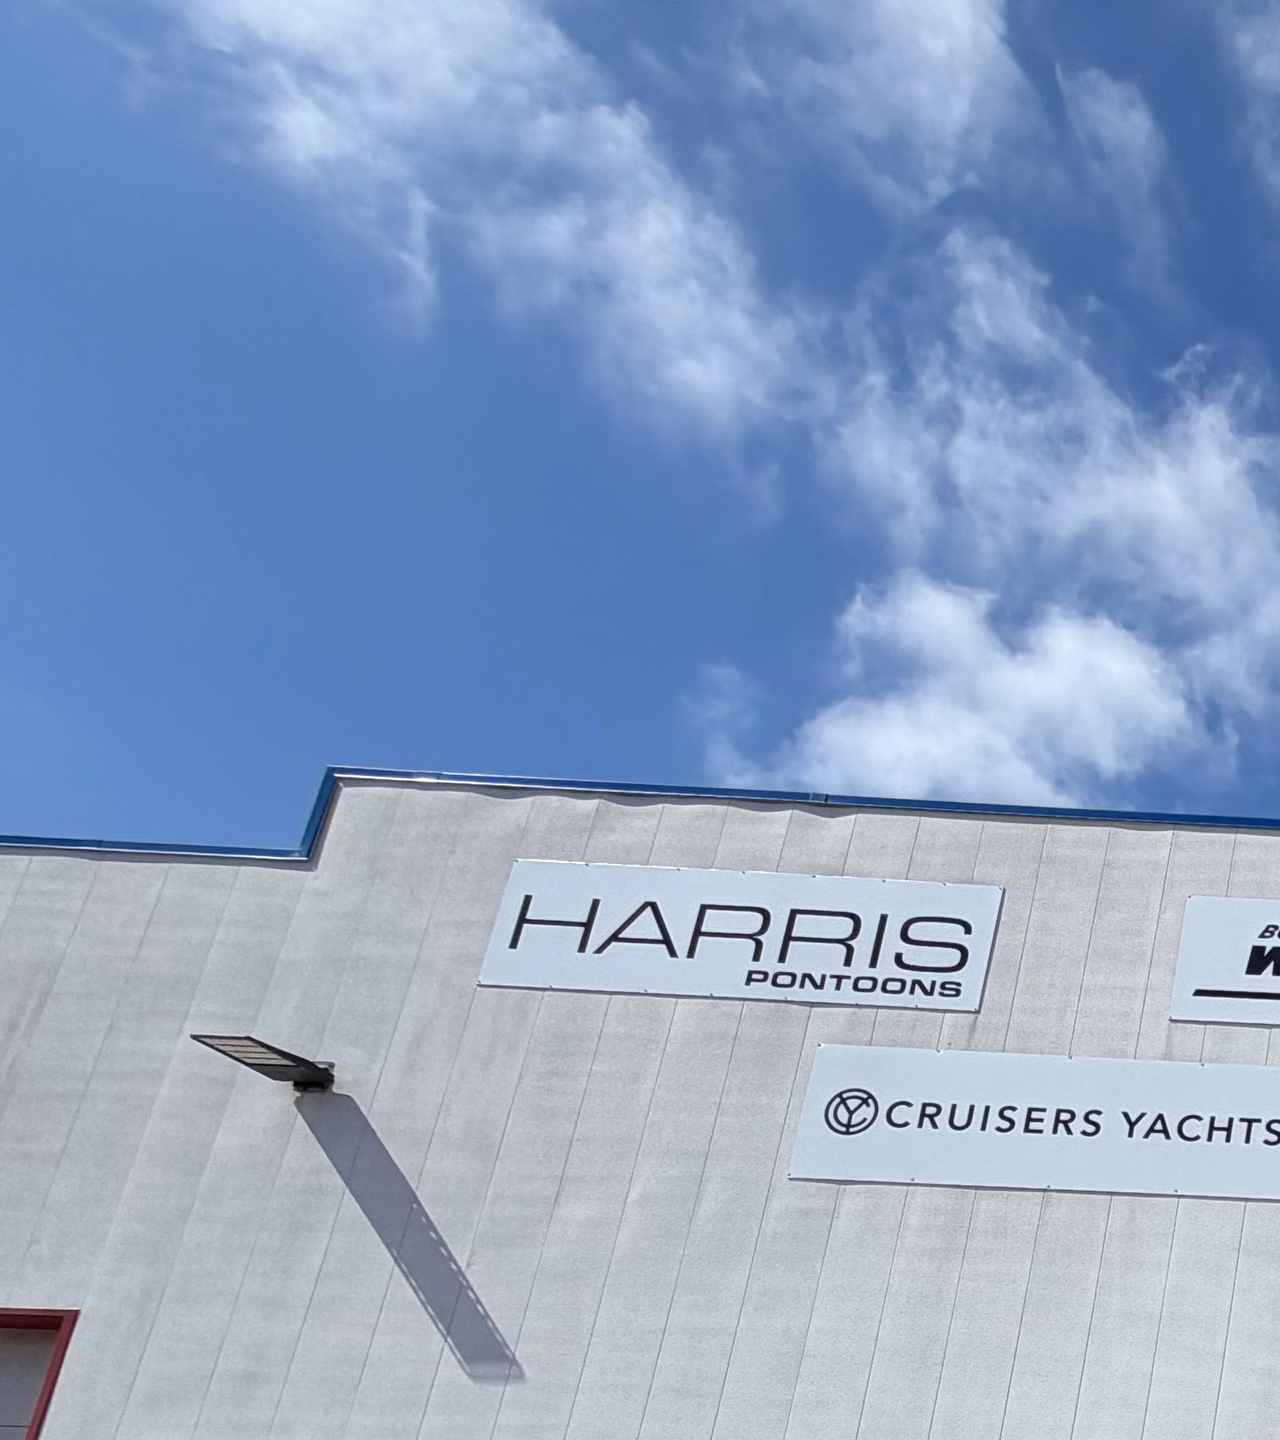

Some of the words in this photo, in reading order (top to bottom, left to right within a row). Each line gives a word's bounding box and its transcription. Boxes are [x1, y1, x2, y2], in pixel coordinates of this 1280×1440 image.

[508, 894, 973, 974] HARRIS
[744, 969, 962, 998] PONTOONS
[885, 1100, 1103, 1137] CRUISERS
